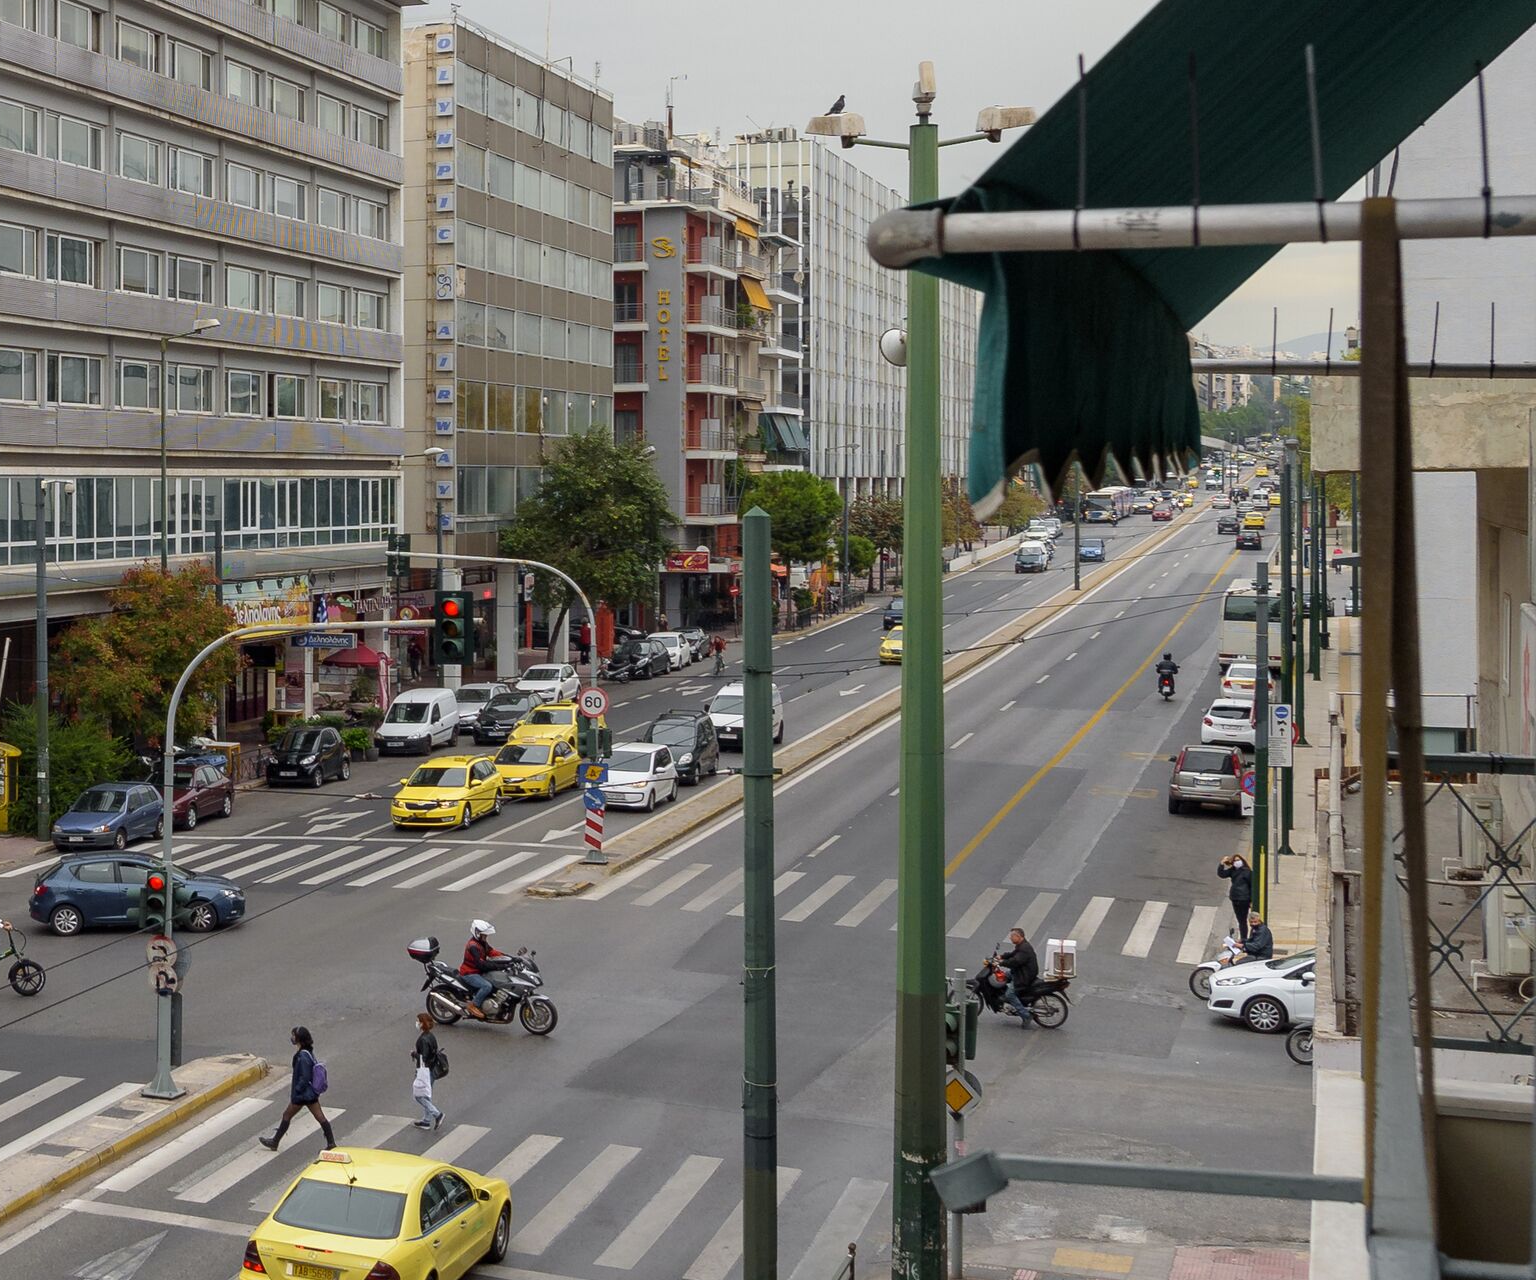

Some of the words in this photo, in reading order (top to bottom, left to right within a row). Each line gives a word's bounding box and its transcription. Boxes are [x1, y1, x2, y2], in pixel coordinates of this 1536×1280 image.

[436, 38, 452, 240] OLYMPIC
[657, 288, 671, 381] HOTEL
[435, 325, 452, 527] AIRWAYS
[585, 696, 602, 708] 60
